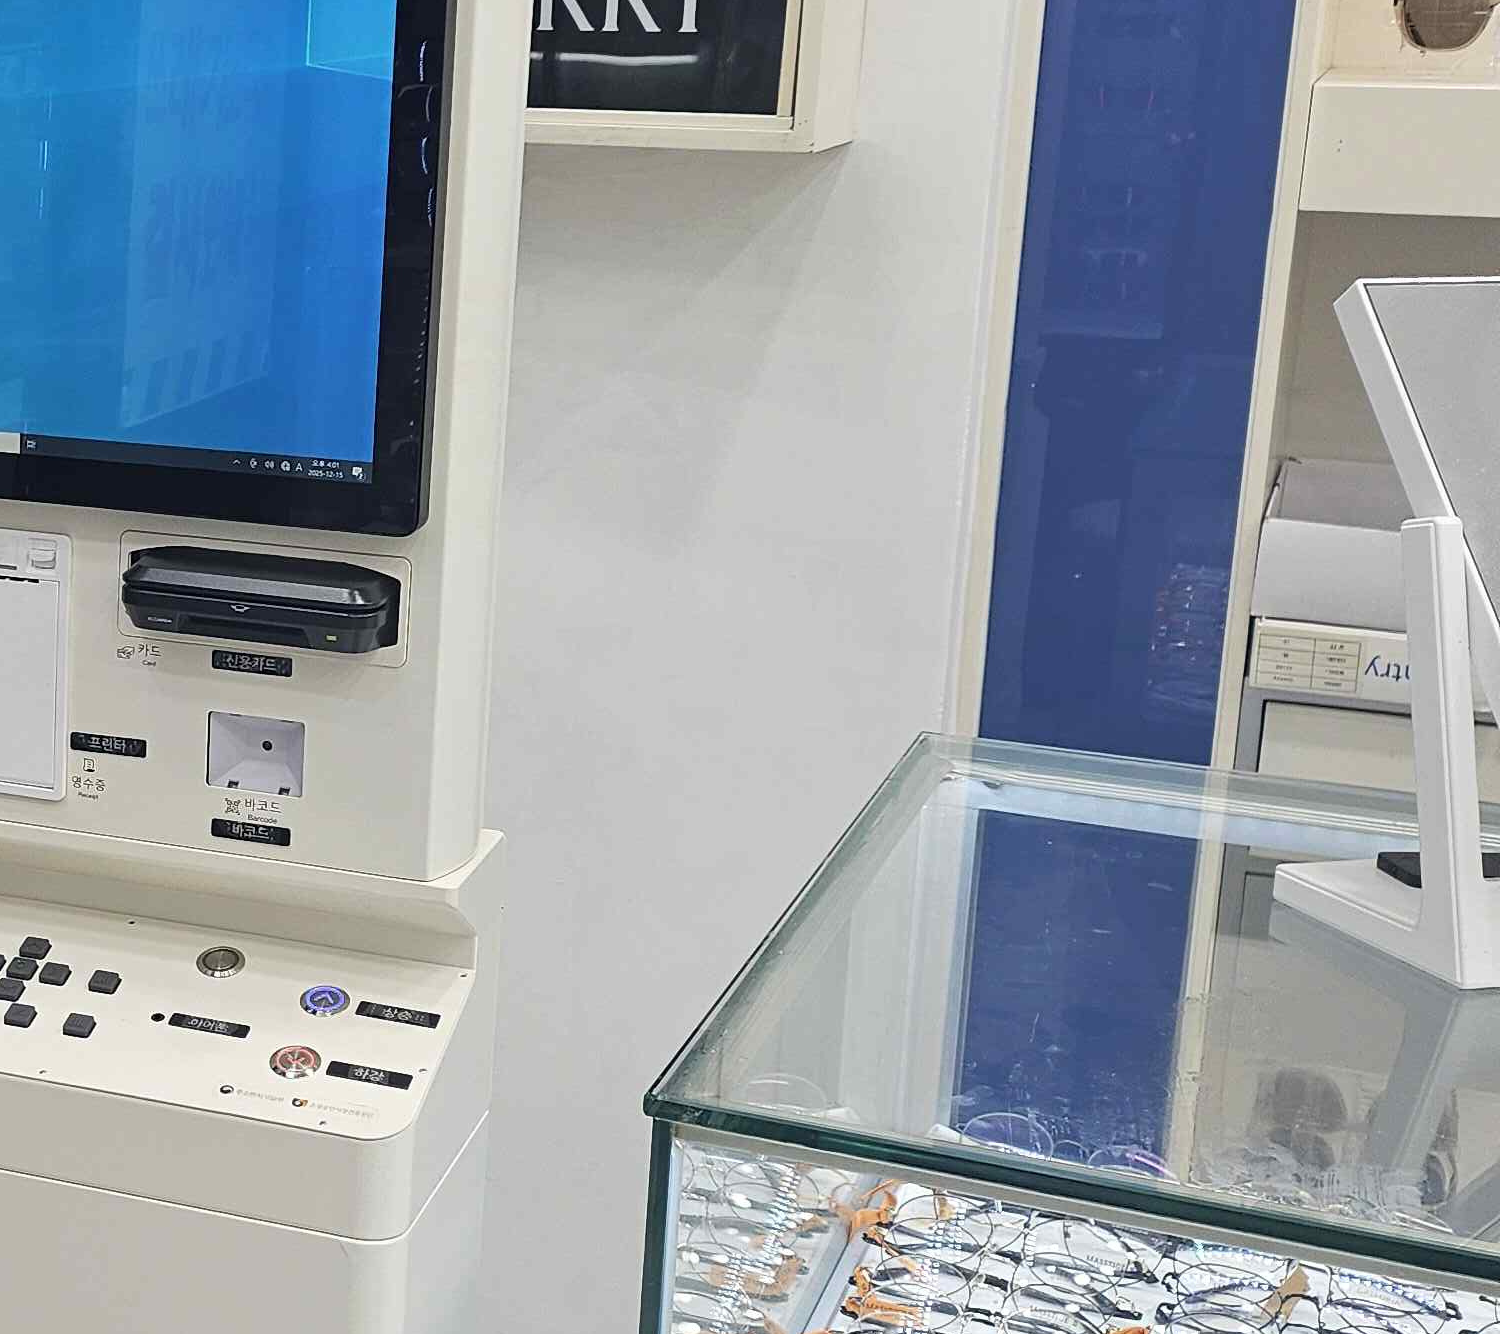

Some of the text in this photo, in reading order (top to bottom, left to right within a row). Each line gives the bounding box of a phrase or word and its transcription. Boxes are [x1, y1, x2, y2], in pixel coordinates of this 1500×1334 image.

[138, 643, 162, 657] 카드
[226, 654, 279, 672] 신용카드
[87, 736, 126, 754] 프린터
[71, 775, 106, 792] 영수증
[244, 798, 282, 814] 바코드
[247, 814, 278, 825] Barcode
[231, 823, 270, 839] 바코드
[382, 1005, 413, 1022] 상승
[354, 1067, 386, 1083] 하강
